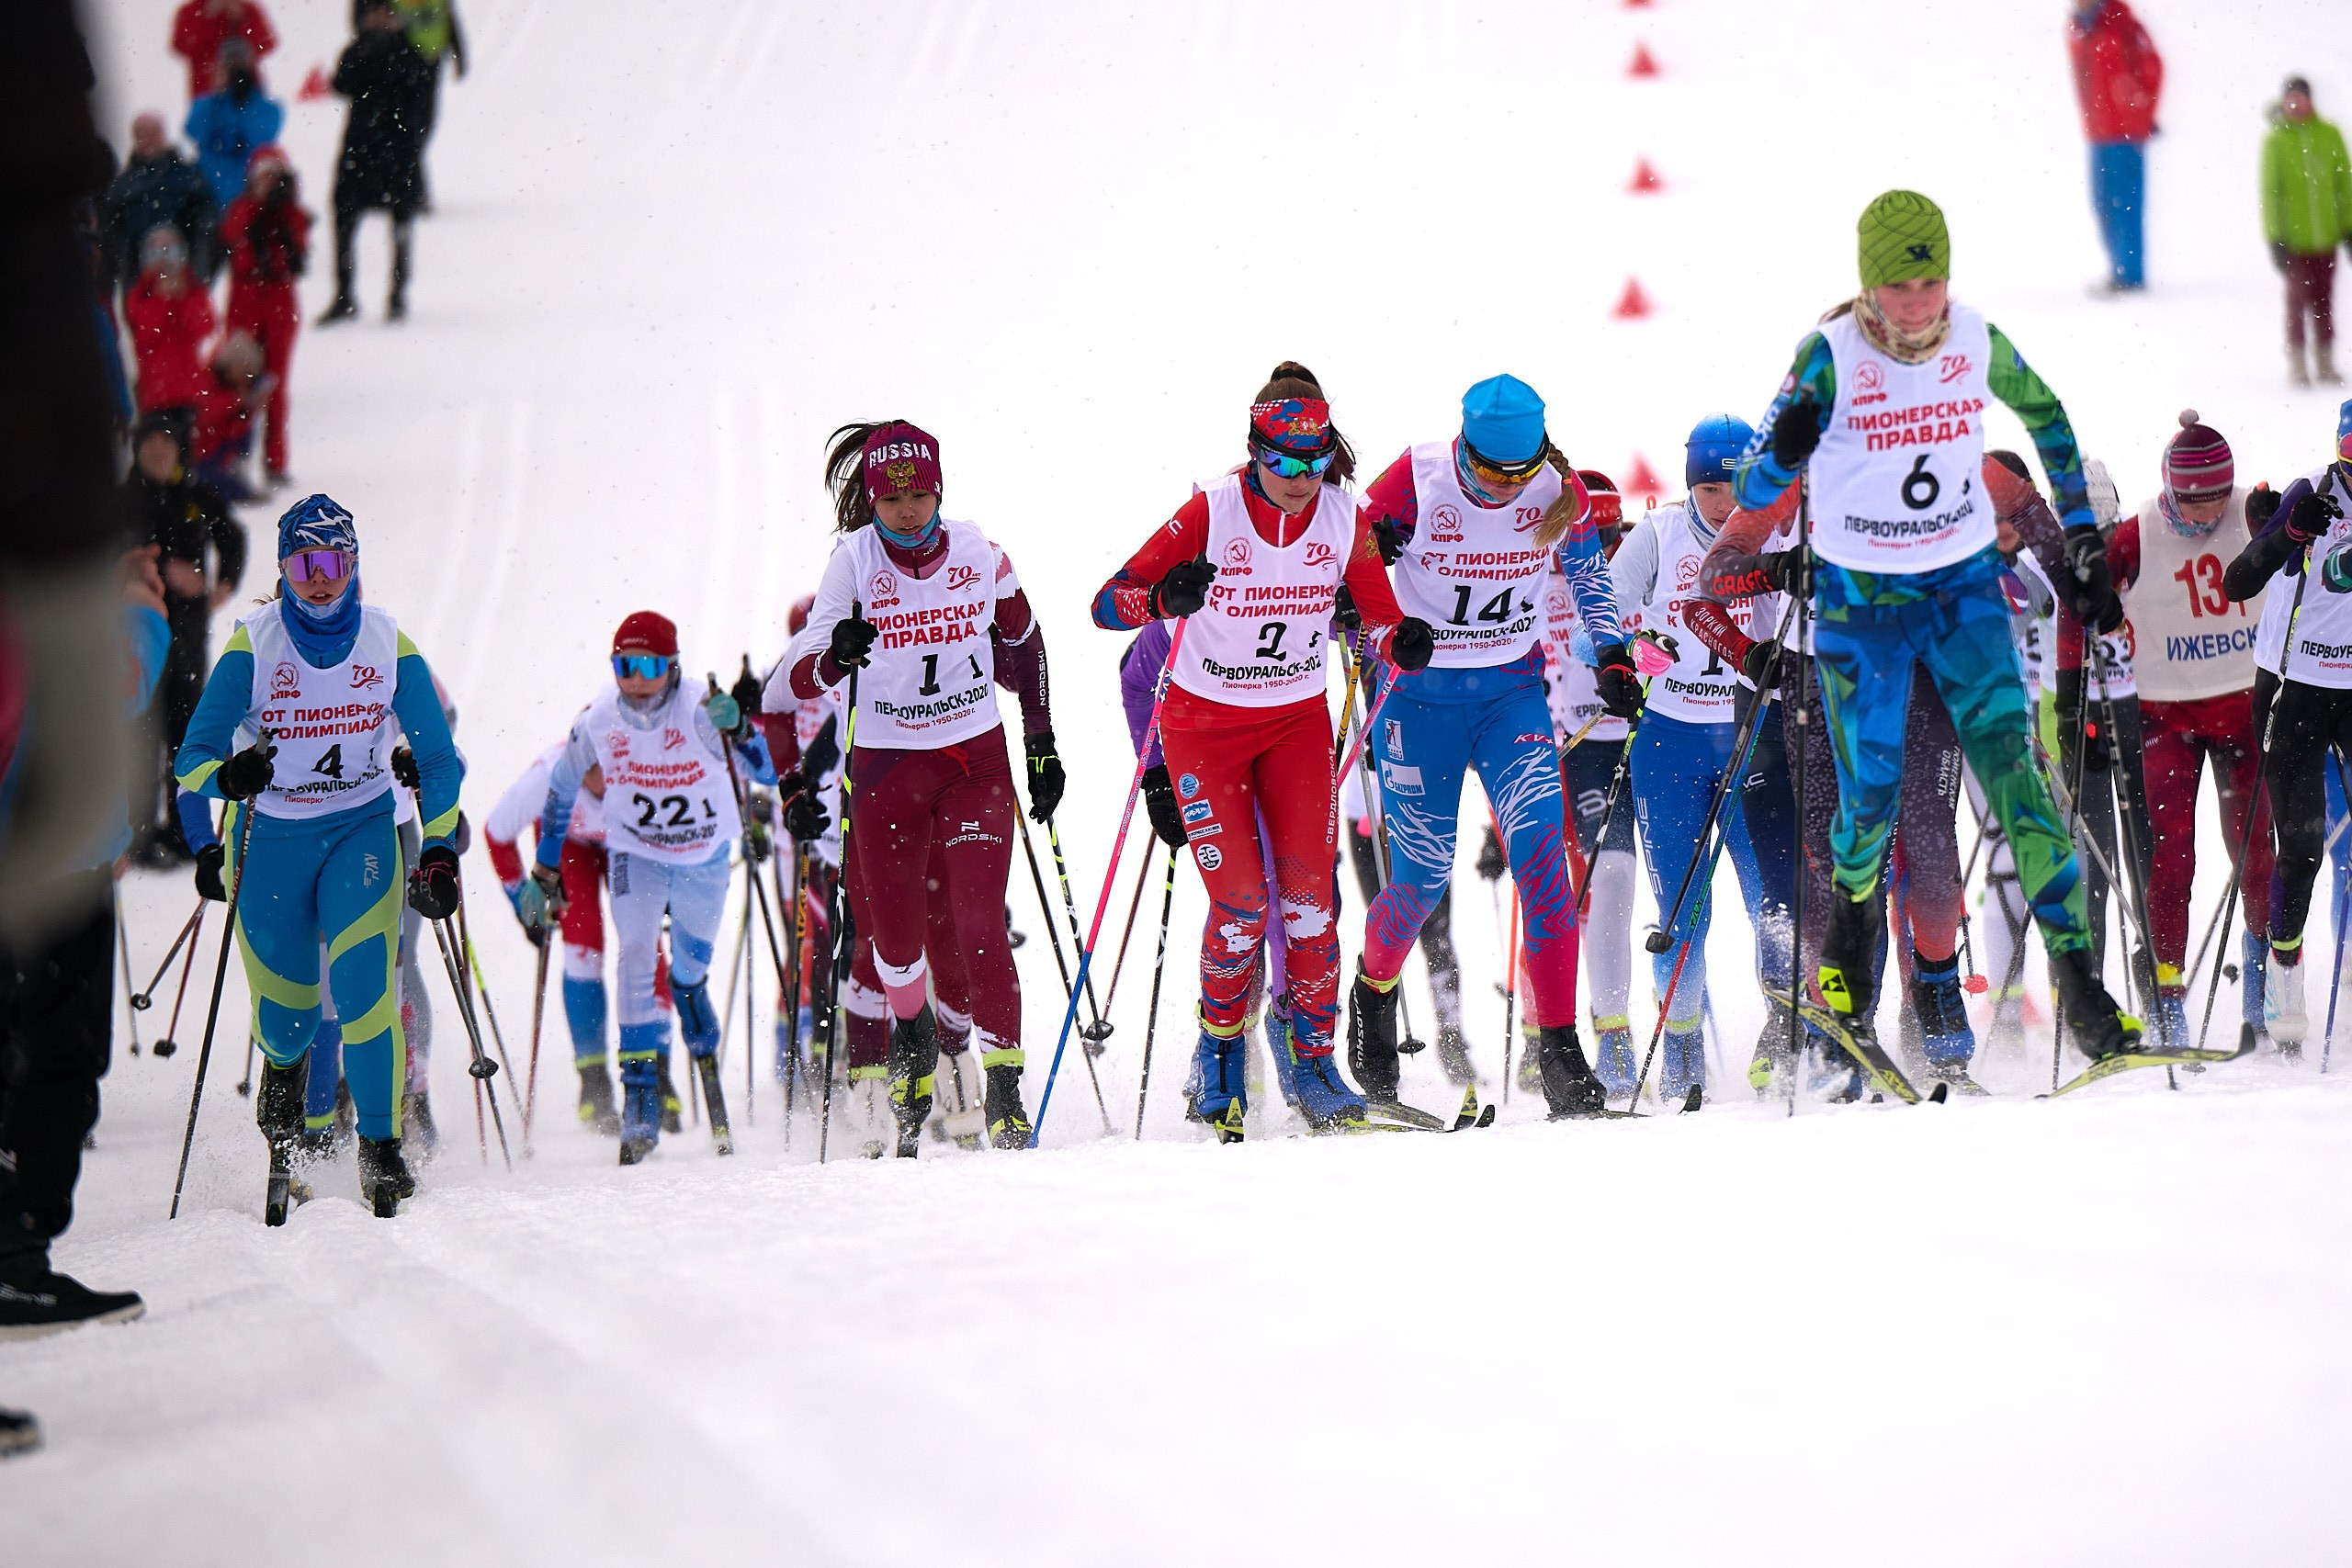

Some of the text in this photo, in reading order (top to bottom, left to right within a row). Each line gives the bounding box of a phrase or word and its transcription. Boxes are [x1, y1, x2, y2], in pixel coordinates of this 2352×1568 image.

[1847, 399, 1984, 430] ПИОНЕРСКАЯ
[1867, 419, 1970, 452] ПРАВДА
[869, 443, 932, 468] RUSSIA
[1901, 454, 1939, 511] 6
[1516, 507, 1541, 525] 70
[1431, 534, 1464, 542] КПРФ
[1306, 542, 1331, 558] 70
[1455, 546, 1550, 565] ПИОНЕРКИ
[947, 565, 972, 583] 70
[1221, 567, 1252, 576] КПРФ
[871, 597, 900, 609] КПРФ
[1212, 584, 1237, 601] ОТ
[1209, 597, 1219, 612] К
[1446, 585, 1516, 626] 14
[867, 601, 986, 631] ПИОНЕРСКАЯ
[1695, 607, 1728, 638] ЗОРКИЙ
[883, 621, 978, 650] ПРАВДА
[1256, 622, 1287, 661] 2
[1470, 638, 1512, 649] 1950-2020
[353, 665, 375, 681] 70
[920, 654, 941, 696] 1
[967, 654, 983, 680] 1
[1037, 650, 1047, 706] NORDSKI
[1222, 682, 1262, 690] Пионерка
[270, 690, 300, 701] КПРФ
[1683, 696, 1720, 706] Пионерка
[262, 703, 386, 723] ОТ ПИОНЕРКИ
[896, 719, 930, 731] Пионерка
[932, 708, 971, 727] 1950-2020
[311, 744, 344, 779] 4
[1938, 750, 1951, 796] ОБЛАСТЬ
[633, 793, 695, 830] 22
[702, 797, 717, 818] 1
[945, 833, 1002, 849] NORDSKI
